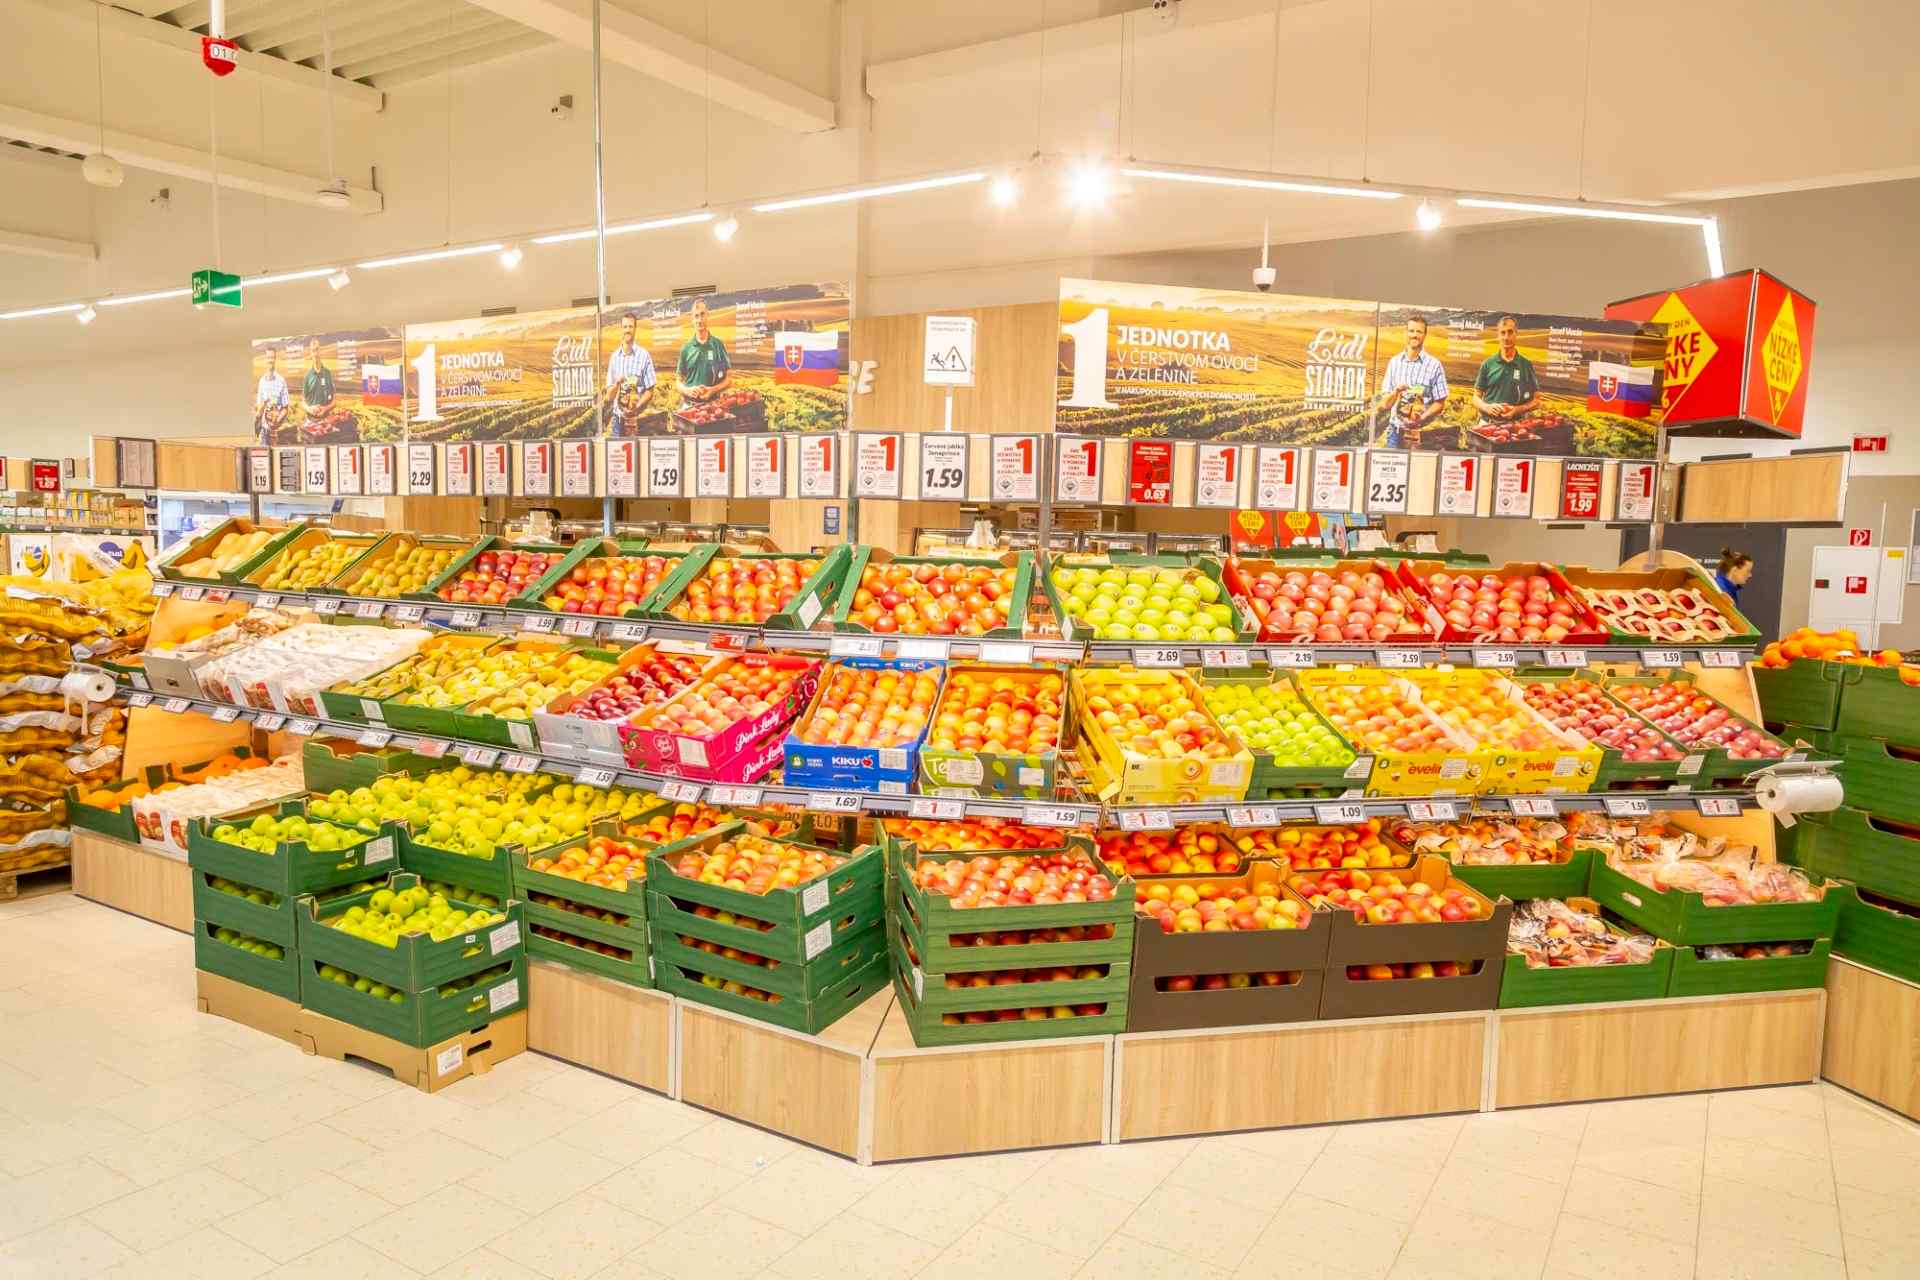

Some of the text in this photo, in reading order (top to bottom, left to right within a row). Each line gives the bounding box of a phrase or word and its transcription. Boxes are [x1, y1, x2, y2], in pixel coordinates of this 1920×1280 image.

[1117, 325, 1231, 351] JEDNOTKA
[1307, 327, 1369, 362] Lidl
[440, 351, 505, 369] JEDNOTKA
[1058, 308, 1119, 408] 1
[1117, 347, 1259, 372] V ČERSTVOM OVOCÍ
[411, 343, 441, 421] 1
[1116, 368, 1198, 385] A ZELENINE
[349, 447, 357, 475] 1
[382, 447, 390, 475] 1
[458, 446, 468, 474] 1
[495, 445, 505, 474] 1
[537, 444, 547, 474] 1
[576, 443, 587, 474] 1
[622, 442, 633, 473] 1
[713, 440, 726, 473] 1
[765, 439, 778, 473] 1
[818, 438, 832, 472] 1
[879, 436, 897, 472] 1
[1015, 438, 1033, 474] 1
[1081, 442, 1097, 477] 1
[1220, 447, 1236, 482] 1
[1279, 449, 1295, 485] 1
[1334, 452, 1350, 487] 1
[308, 471, 325, 486] 1.59
[411, 471, 431, 486] 2.29
[652, 468, 678, 487] 1.59
[926, 468, 963, 488] 1.59
[1460, 458, 1474, 492] 1
[1516, 461, 1530, 493] 1
[1638, 466, 1652, 498] 1
[1371, 483, 1406, 503] 2.35
[1570, 498, 1592, 513] 1.99
[574, 621, 580, 633] 1
[1157, 650, 1178, 662] 2.69
[1219, 650, 1227, 664] 1
[1295, 652, 1312, 663] 2.19
[1401, 653, 1419, 664] 2.59
[1560, 651, 1568, 664] 1
[1663, 652, 1680, 663] 1.59
[1715, 652, 1723, 664] 1
[735, 711, 780, 752] Pink Lady
[743, 753, 766, 782] Pink
[831, 756, 860, 766] KIKU
[928, 757, 947, 775] Te
[673, 785, 683, 797] 1
[729, 789, 737, 801] 1
[835, 796, 857, 807] 1.69
[930, 802, 938, 814] 1
[1341, 805, 1361, 818] 1.09
[1424, 804, 1434, 818] 1
[1525, 800, 1536, 813] 1
[1713, 800, 1721, 813] 1
[1055, 811, 1075, 822] 1.59
[1139, 812, 1147, 826] 1
[1246, 809, 1254, 823] 1
